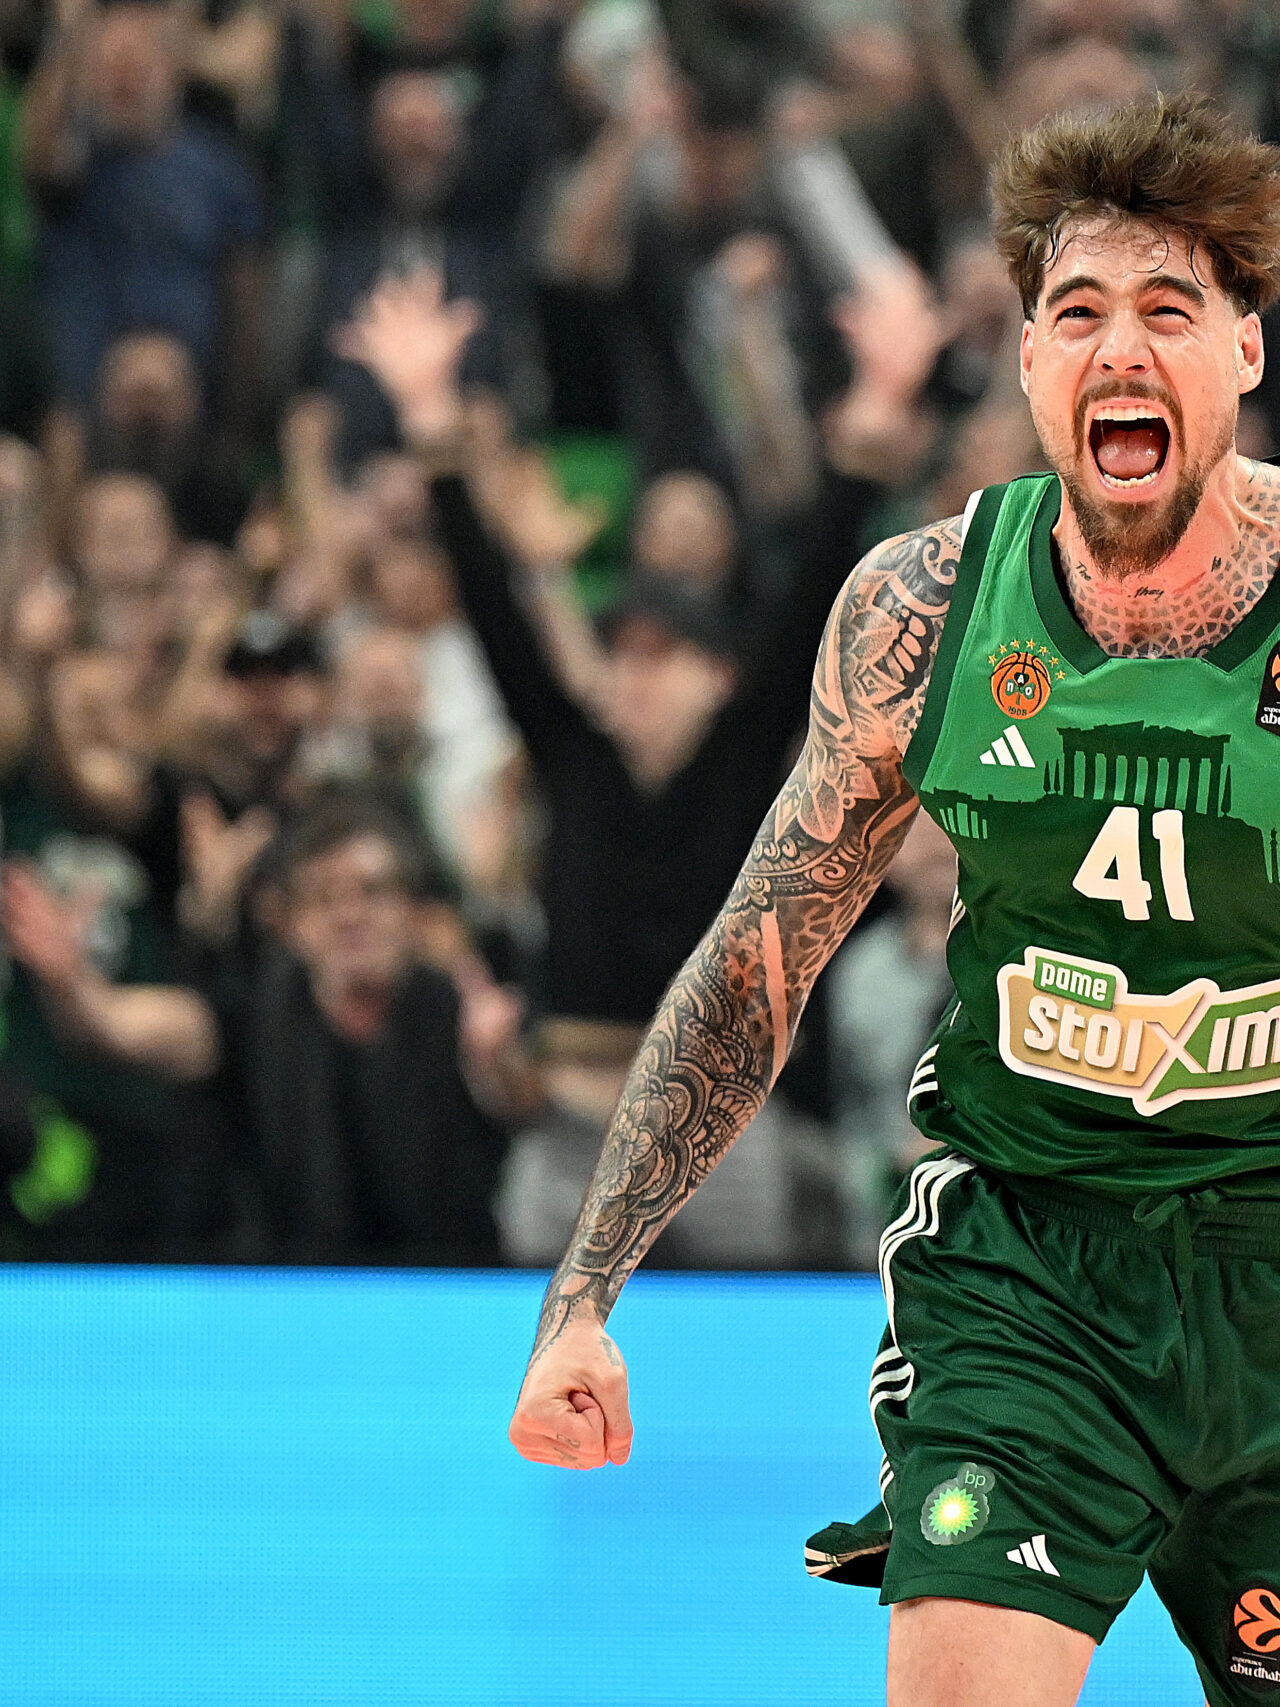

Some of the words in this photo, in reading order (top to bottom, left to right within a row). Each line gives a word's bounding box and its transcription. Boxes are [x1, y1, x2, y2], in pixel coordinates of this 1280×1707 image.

[1072, 806, 1195, 922] 41
[1040, 962, 1108, 1002] pame
[964, 1470, 986, 1488] bp
[1230, 1663, 1252, 1676] abu
